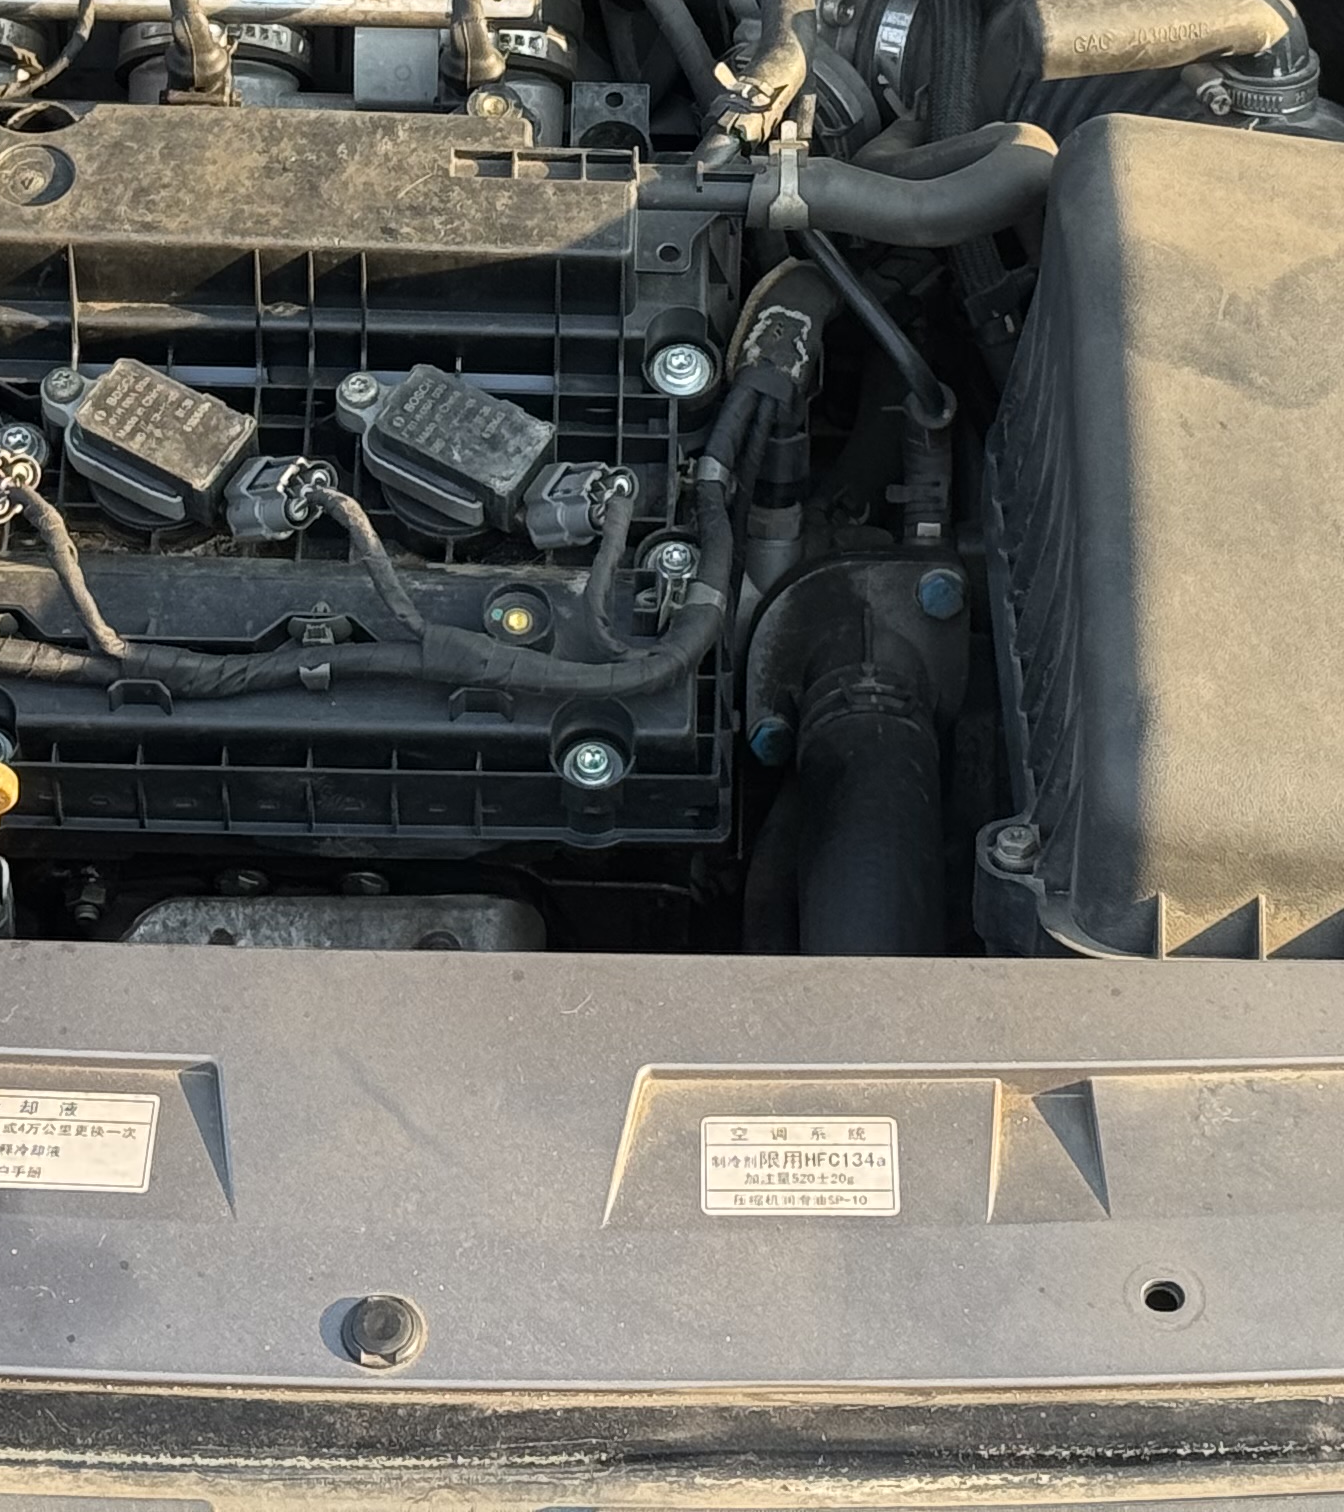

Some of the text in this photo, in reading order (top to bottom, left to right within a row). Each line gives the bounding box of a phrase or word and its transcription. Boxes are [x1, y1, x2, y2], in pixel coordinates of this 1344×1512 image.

[1073, 32, 1114, 54] GAC
[103, 369, 140, 407] BOSCH
[139, 381, 166, 408] China
[401, 376, 436, 413] BOSCH
[730, 1126, 867, 1142] 空调系统
